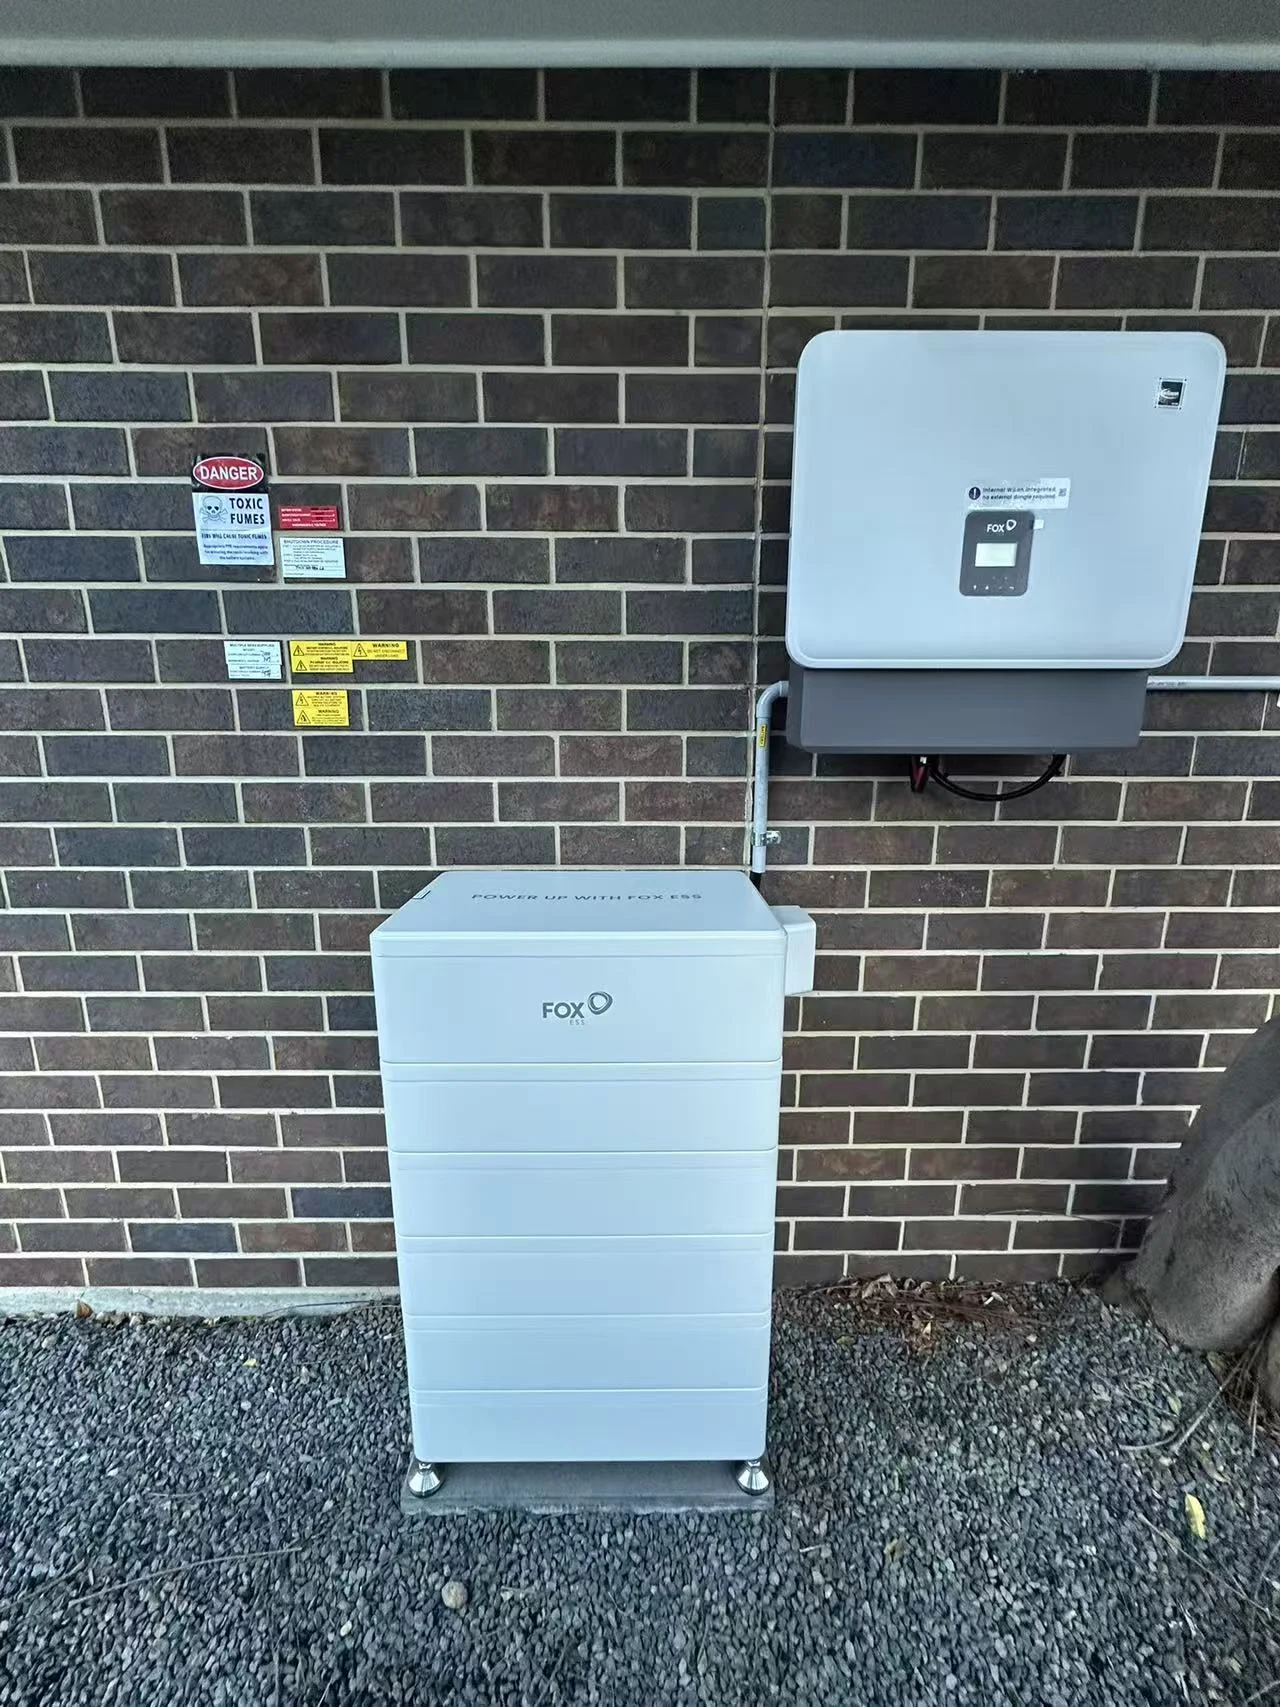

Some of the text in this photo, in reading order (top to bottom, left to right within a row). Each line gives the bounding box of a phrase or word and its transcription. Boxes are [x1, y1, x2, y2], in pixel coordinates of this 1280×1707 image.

[200, 466, 258, 480] DANGER
[229, 498, 263, 509] TOXIC
[230, 513, 265, 524] FUMES
[986, 523, 1005, 532] FOX
[541, 1002, 585, 1019] FOX
